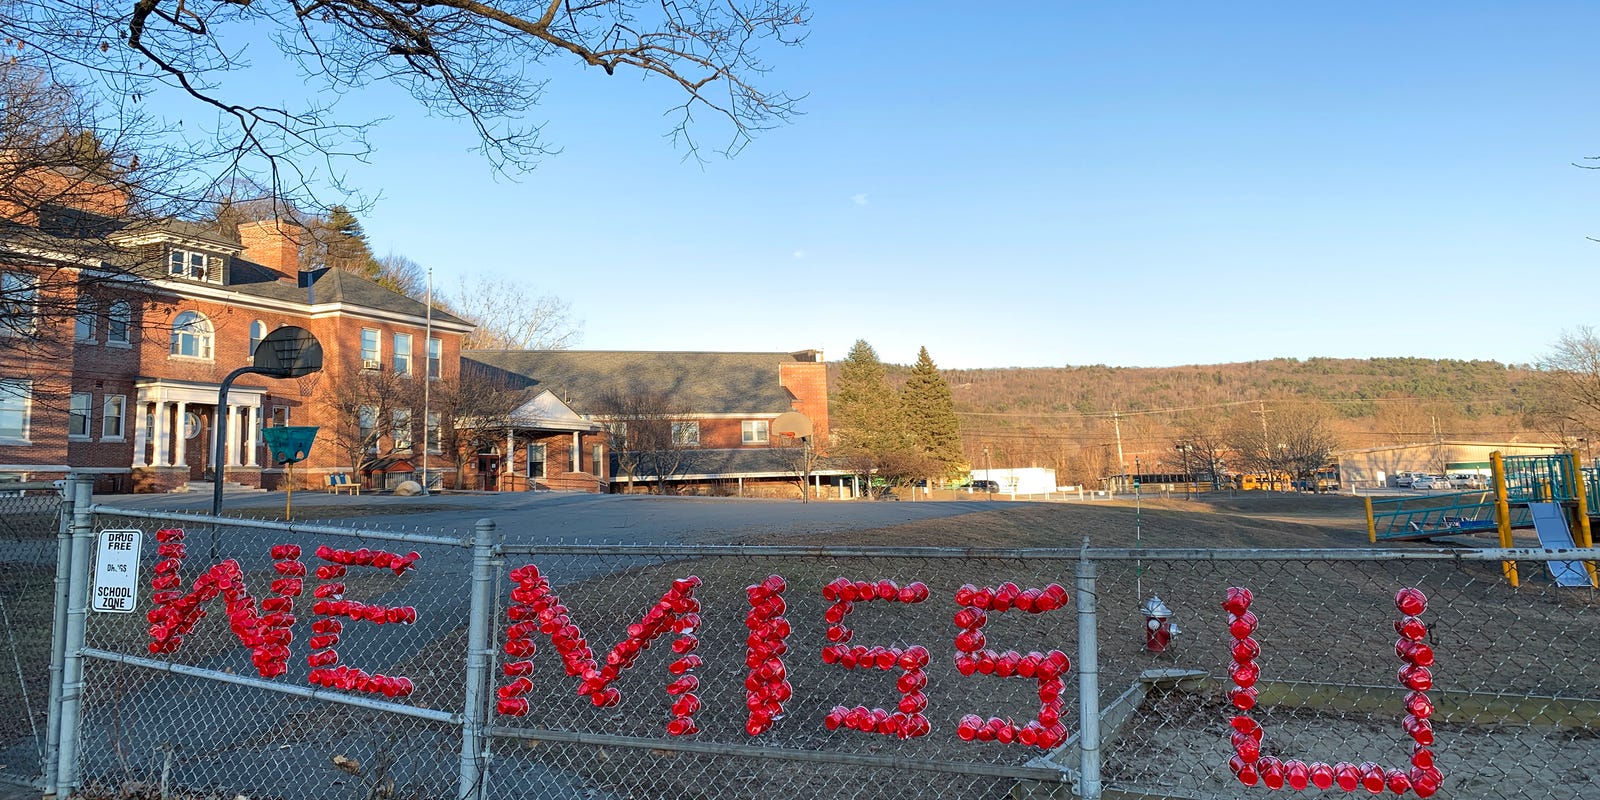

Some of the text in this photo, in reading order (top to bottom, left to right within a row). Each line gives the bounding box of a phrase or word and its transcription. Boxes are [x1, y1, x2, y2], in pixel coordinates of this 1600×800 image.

[108, 533, 133, 541] DRUG
[108, 542, 131, 550] FREE
[98, 587, 131, 597] SCHOOL
[103, 598, 125, 607] ZONE
[147, 528, 1443, 798] WE MISS U
